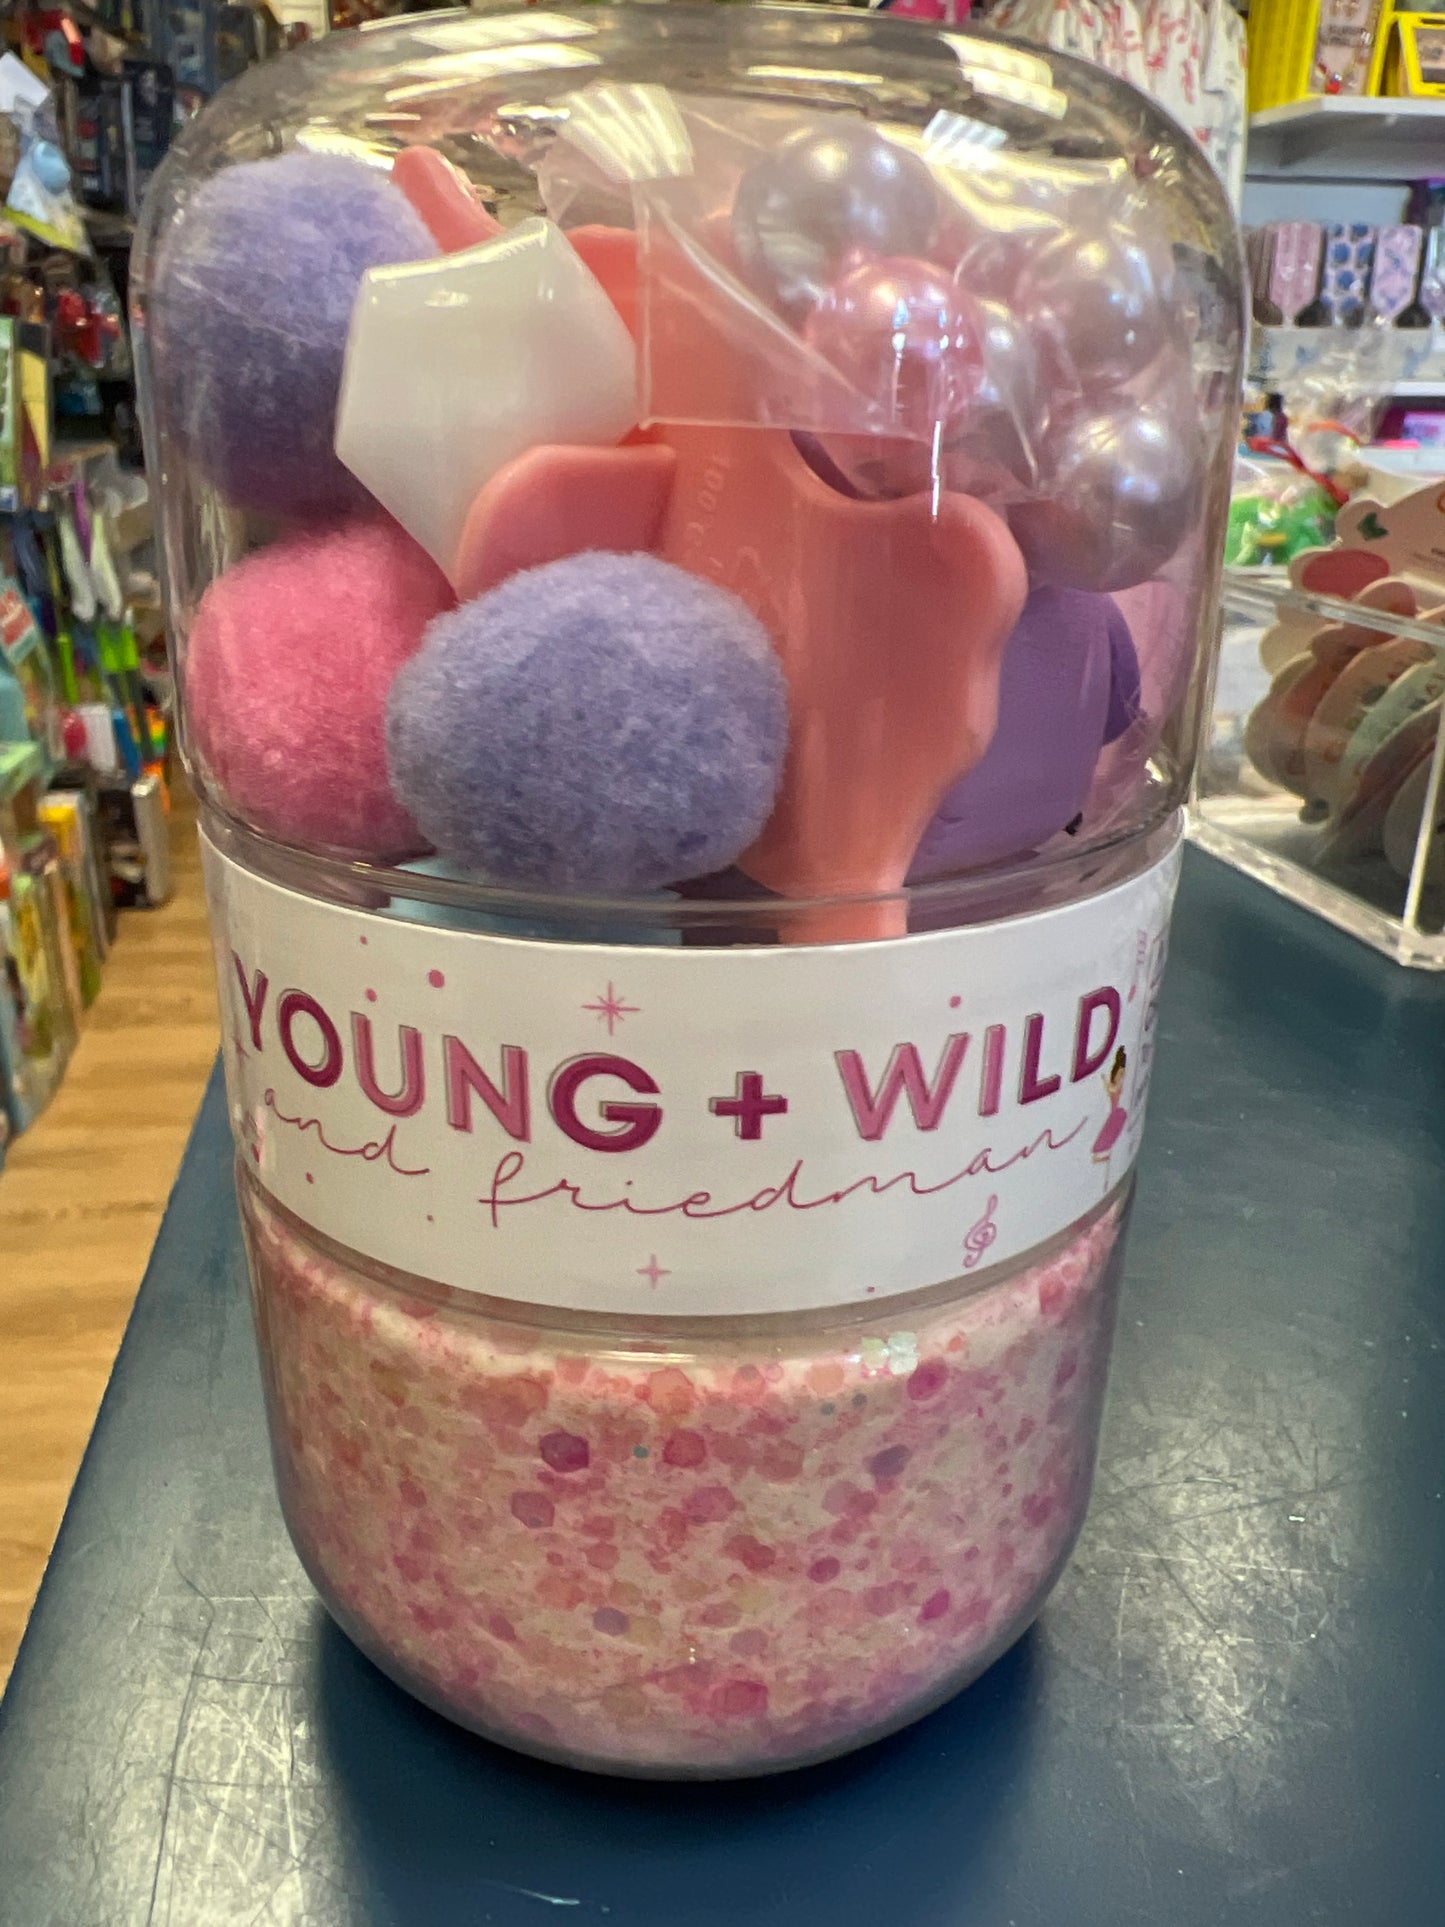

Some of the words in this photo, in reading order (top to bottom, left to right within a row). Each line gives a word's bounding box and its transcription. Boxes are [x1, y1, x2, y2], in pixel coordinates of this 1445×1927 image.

[232, 949, 662, 1153] YOUNG
[709, 1071, 788, 1140] +
[834, 986, 1122, 1141] WILD
[262, 1087, 429, 1175] and
[478, 1117, 1087, 1227] friedman
